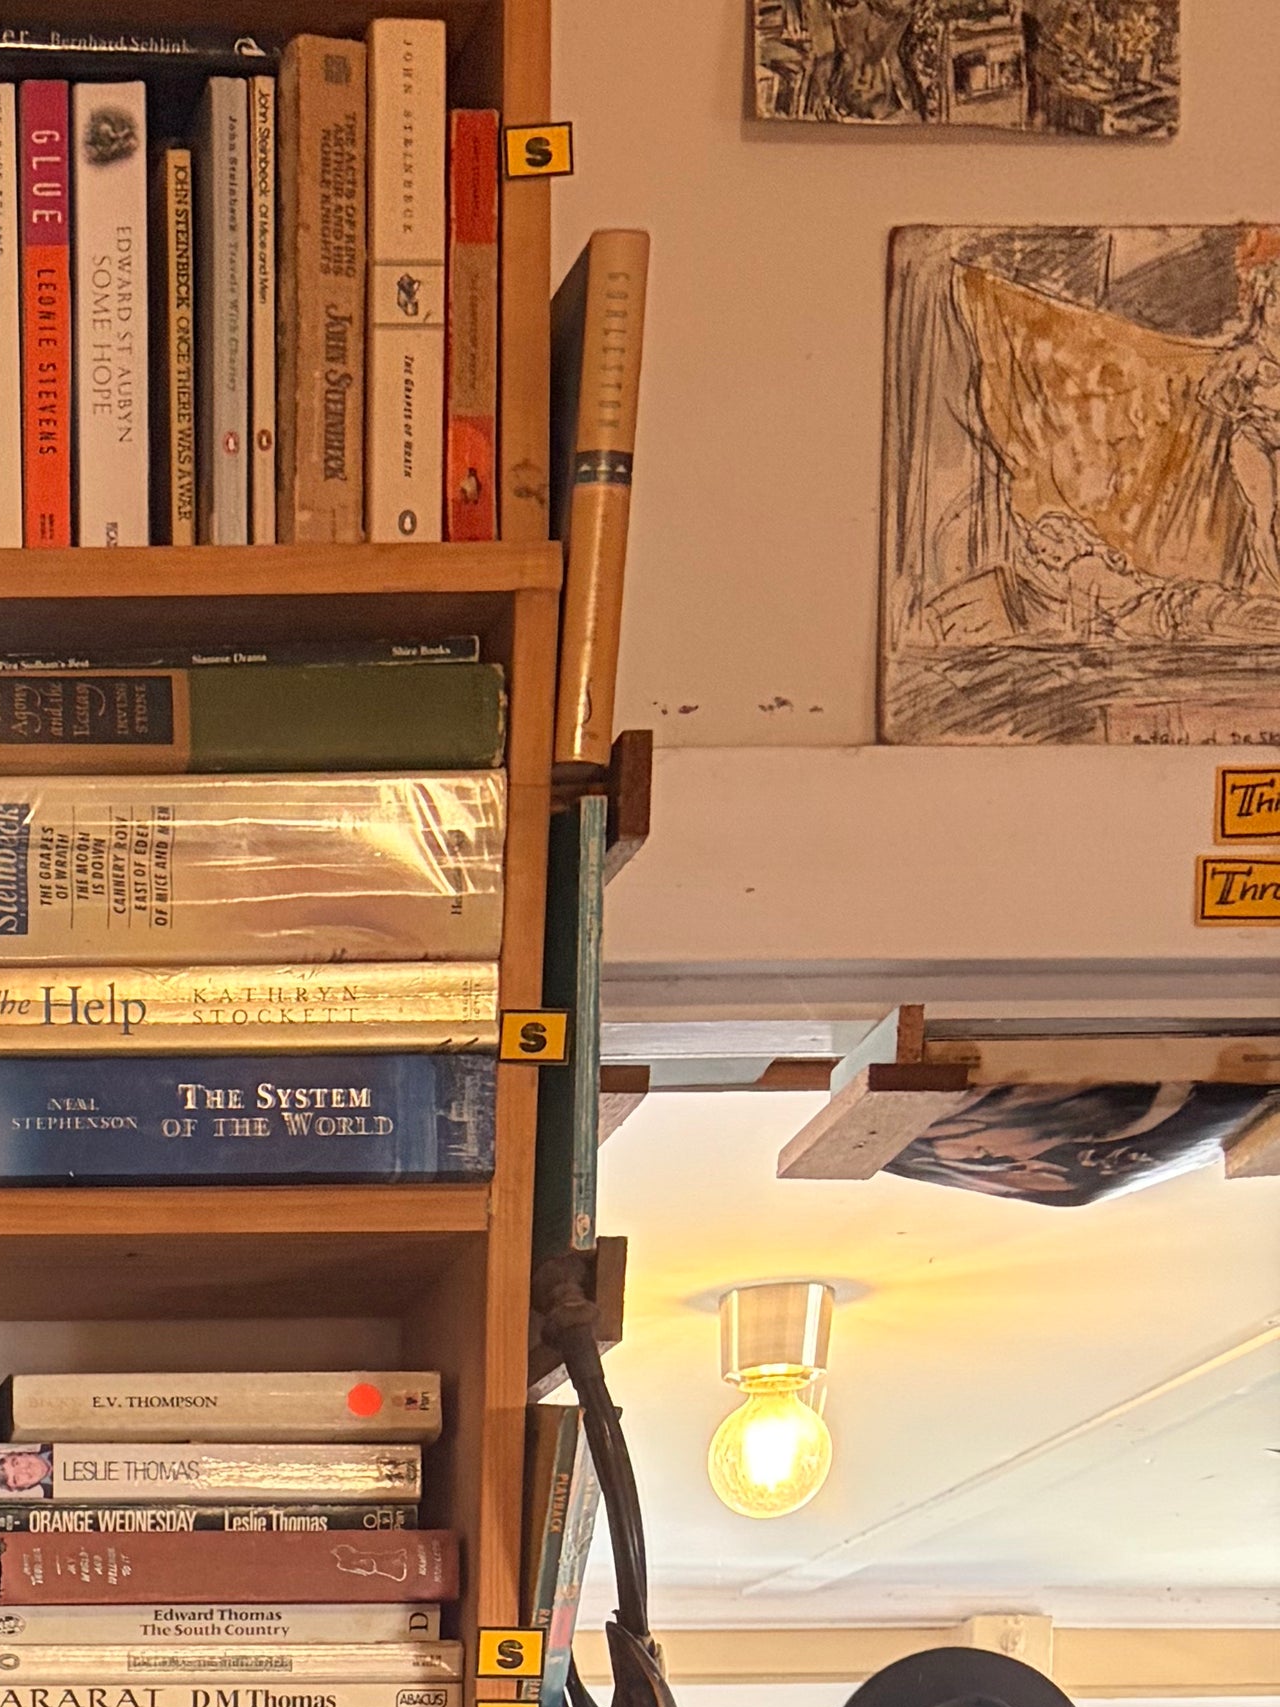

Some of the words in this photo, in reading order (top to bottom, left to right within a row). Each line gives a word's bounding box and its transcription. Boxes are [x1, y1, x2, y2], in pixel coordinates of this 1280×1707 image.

[526, 136, 553, 166] S
[31, 128, 62, 226] GLUE
[519, 1021, 547, 1054] S
[178, 1084, 245, 1109] THE
[496, 1639, 522, 1668] S
